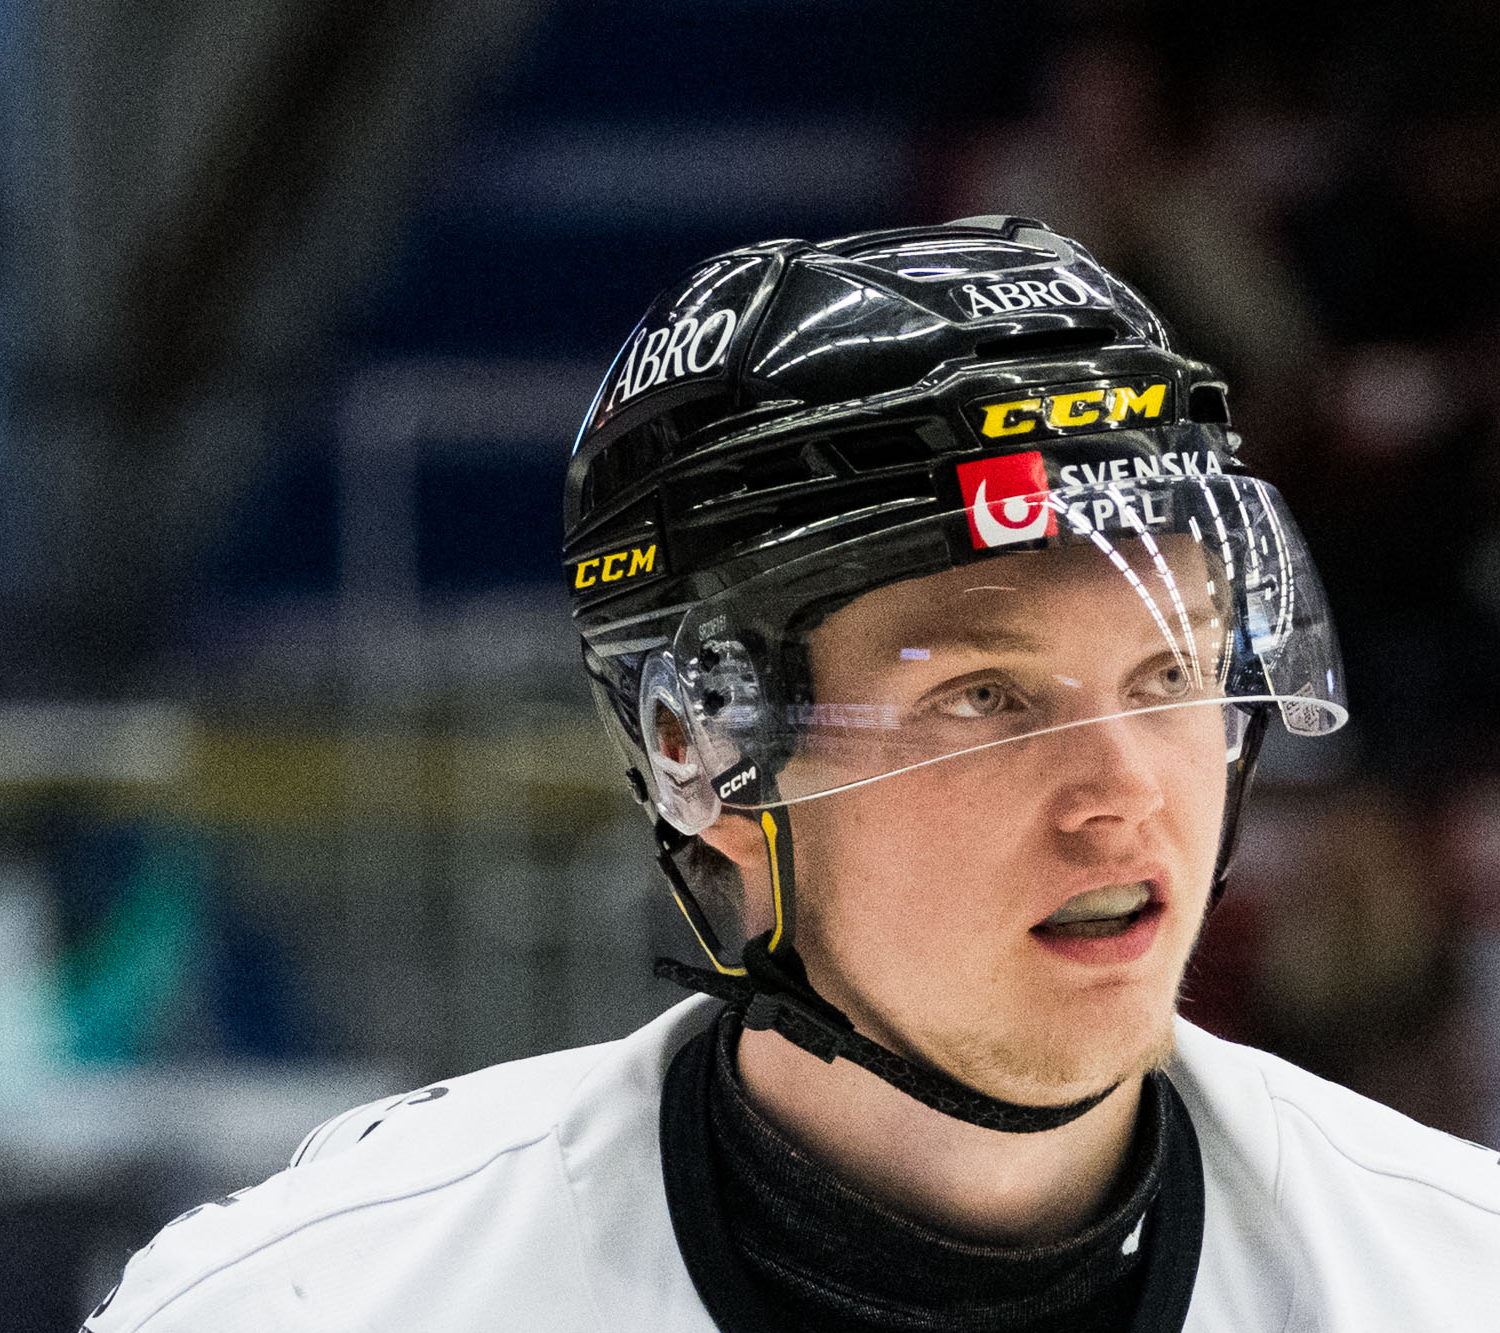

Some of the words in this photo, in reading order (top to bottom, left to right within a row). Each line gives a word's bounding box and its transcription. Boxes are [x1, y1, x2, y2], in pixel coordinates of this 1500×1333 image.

[961, 279, 1088, 319] ÅBRO
[605, 308, 737, 412] ÅBRO
[981, 384, 1167, 438] CCM
[1059, 451, 1224, 495] SVENSKA
[1066, 493, 1167, 535] SPEL
[574, 544, 657, 589] CCM
[719, 765, 757, 800] CCM
